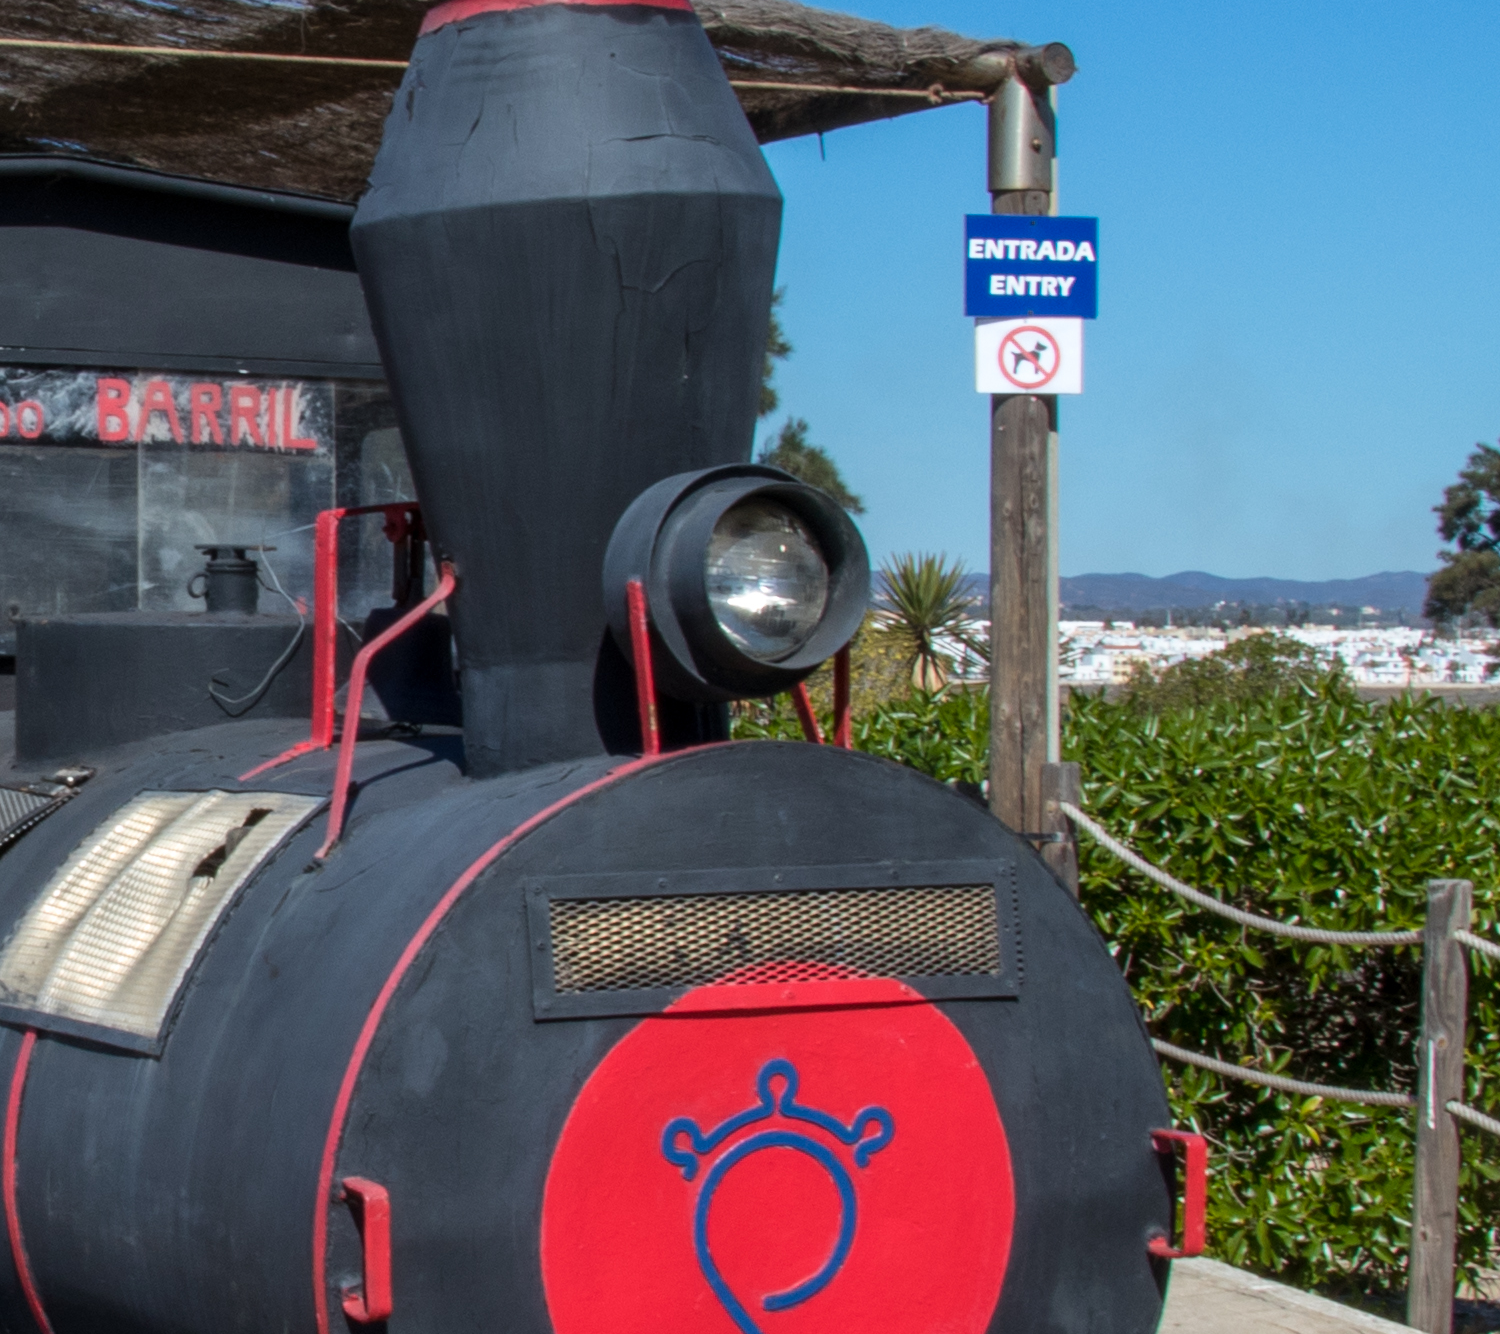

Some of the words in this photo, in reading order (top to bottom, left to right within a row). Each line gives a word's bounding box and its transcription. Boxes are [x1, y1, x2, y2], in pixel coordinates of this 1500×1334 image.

[968, 238, 1096, 262] ENTRADA
[989, 274, 1075, 297] ENTRY
[97, 376, 317, 451] BARRIL
